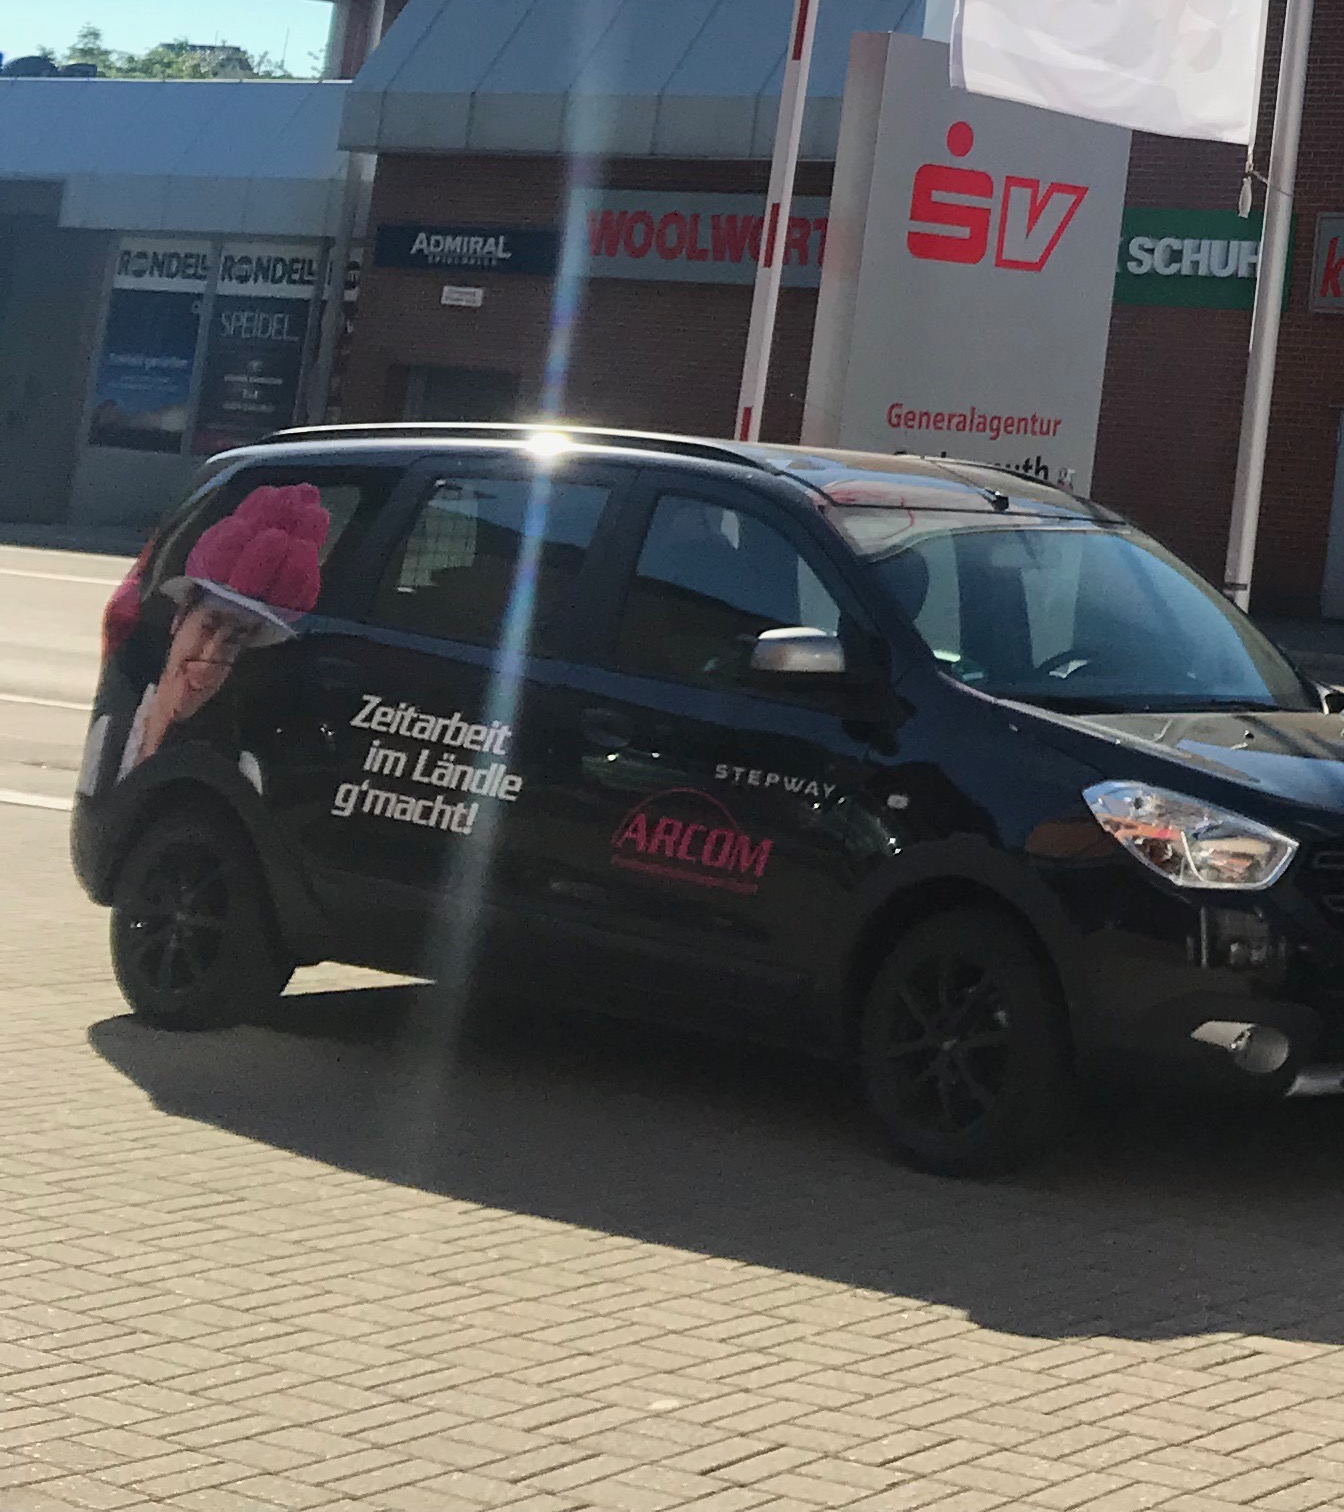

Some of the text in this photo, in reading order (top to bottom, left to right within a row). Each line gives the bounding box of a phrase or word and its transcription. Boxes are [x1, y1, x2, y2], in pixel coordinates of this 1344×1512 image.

[410, 232, 512, 260] ADMIRAL
[220, 309, 300, 340] SPEIDEL
[886, 402, 1062, 440] Generalagentur
[350, 694, 513, 756] Zeitarbeit
[362, 740, 523, 802] im Ländle
[714, 763, 838, 798] STEPWAY
[616, 813, 774, 878] ARCOM
